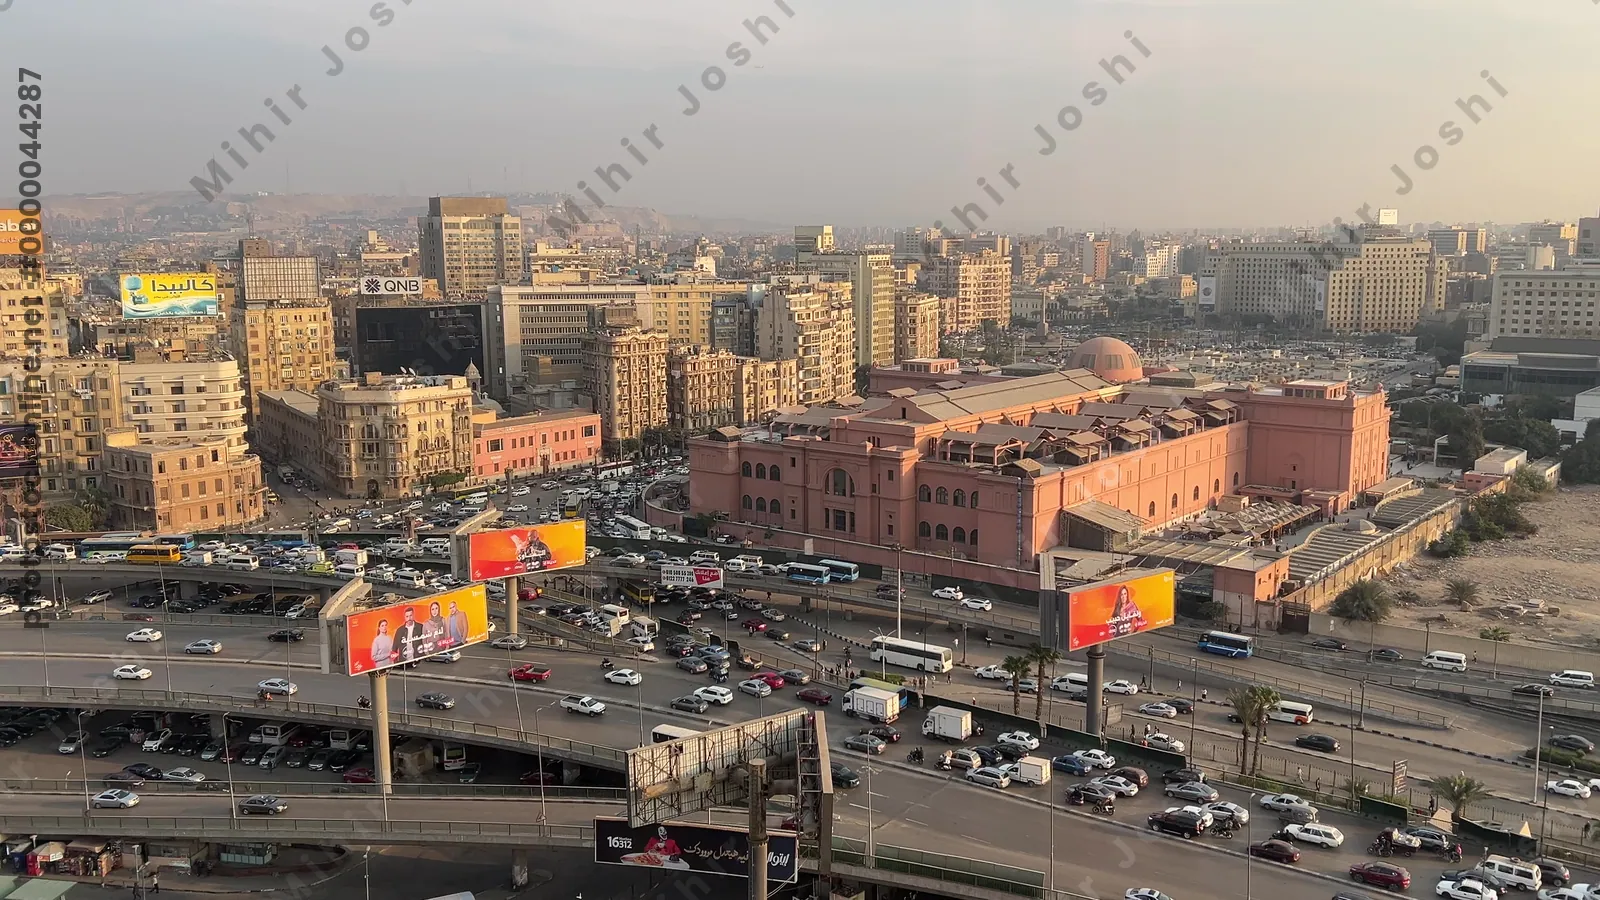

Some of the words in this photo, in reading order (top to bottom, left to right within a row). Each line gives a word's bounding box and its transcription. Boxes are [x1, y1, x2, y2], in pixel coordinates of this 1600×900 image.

[152, 279, 213, 294] كالبيدا
[384, 280, 419, 292] QNB
[401, 629, 433, 644] شمسية
